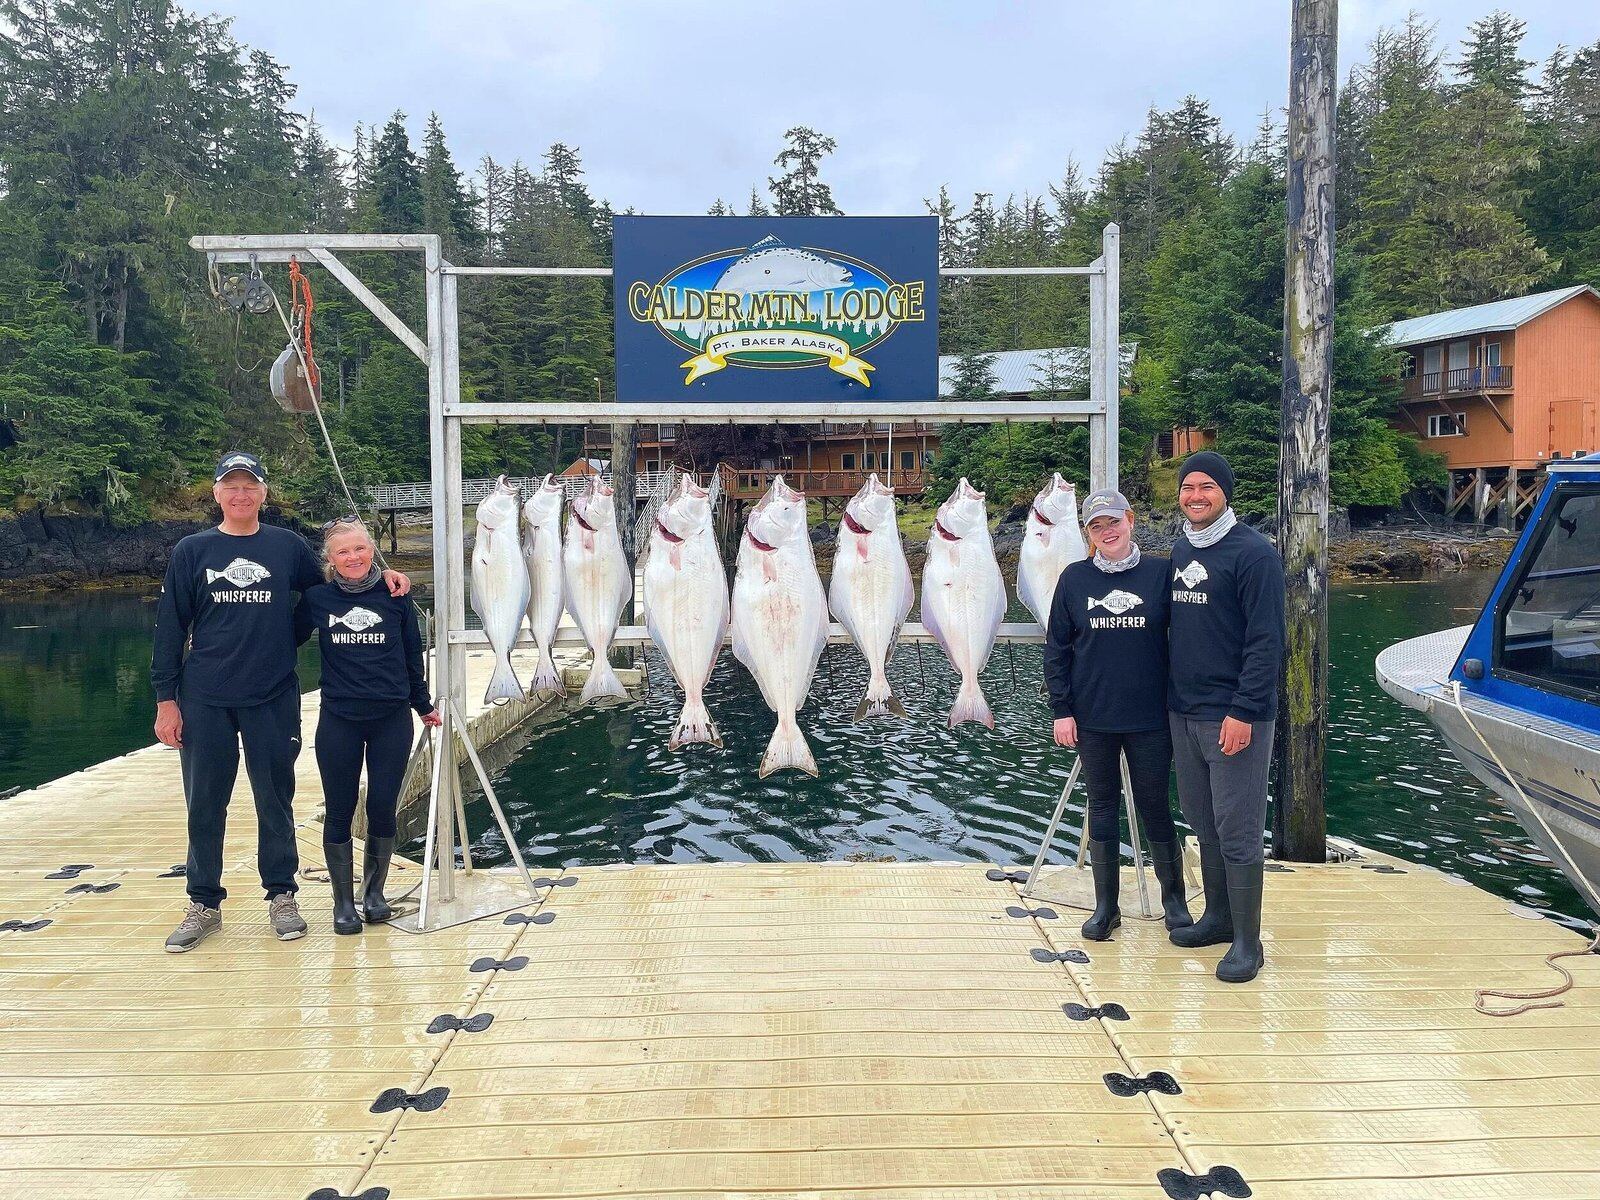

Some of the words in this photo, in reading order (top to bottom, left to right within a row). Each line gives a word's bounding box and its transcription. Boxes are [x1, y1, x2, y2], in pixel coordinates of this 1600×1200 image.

[628, 281, 744, 323] CALDER
[748, 291, 818, 323] MTN.
[824, 280, 925, 323] LODGE
[211, 590, 272, 603] WHISPERER
[1089, 616, 1146, 629] WHISPERER
[331, 633, 386, 644] WHISPERER
